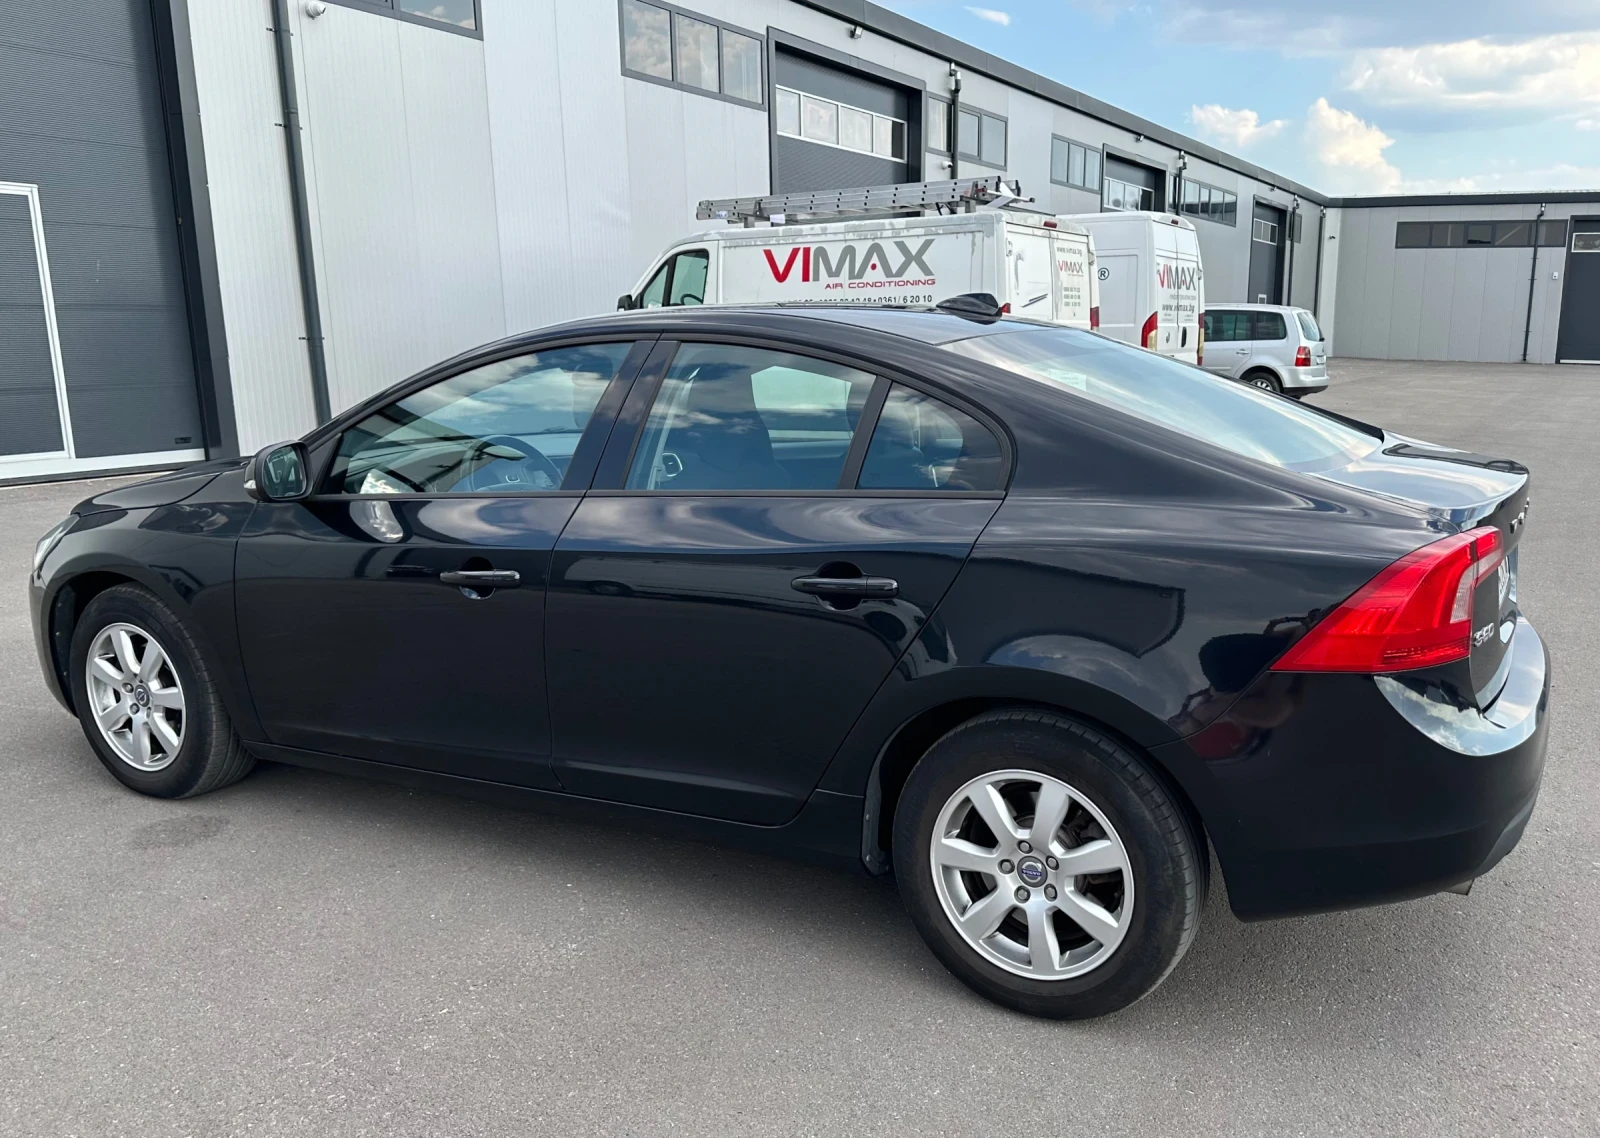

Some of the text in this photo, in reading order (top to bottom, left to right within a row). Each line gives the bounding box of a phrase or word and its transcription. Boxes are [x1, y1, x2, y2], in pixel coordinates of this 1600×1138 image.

[763, 239, 935, 283] VIMAX
[1058, 260, 1084, 274] VIMAX
[848, 279, 936, 289] CONDITIONING
[1159, 264, 1196, 291] VIMAX
